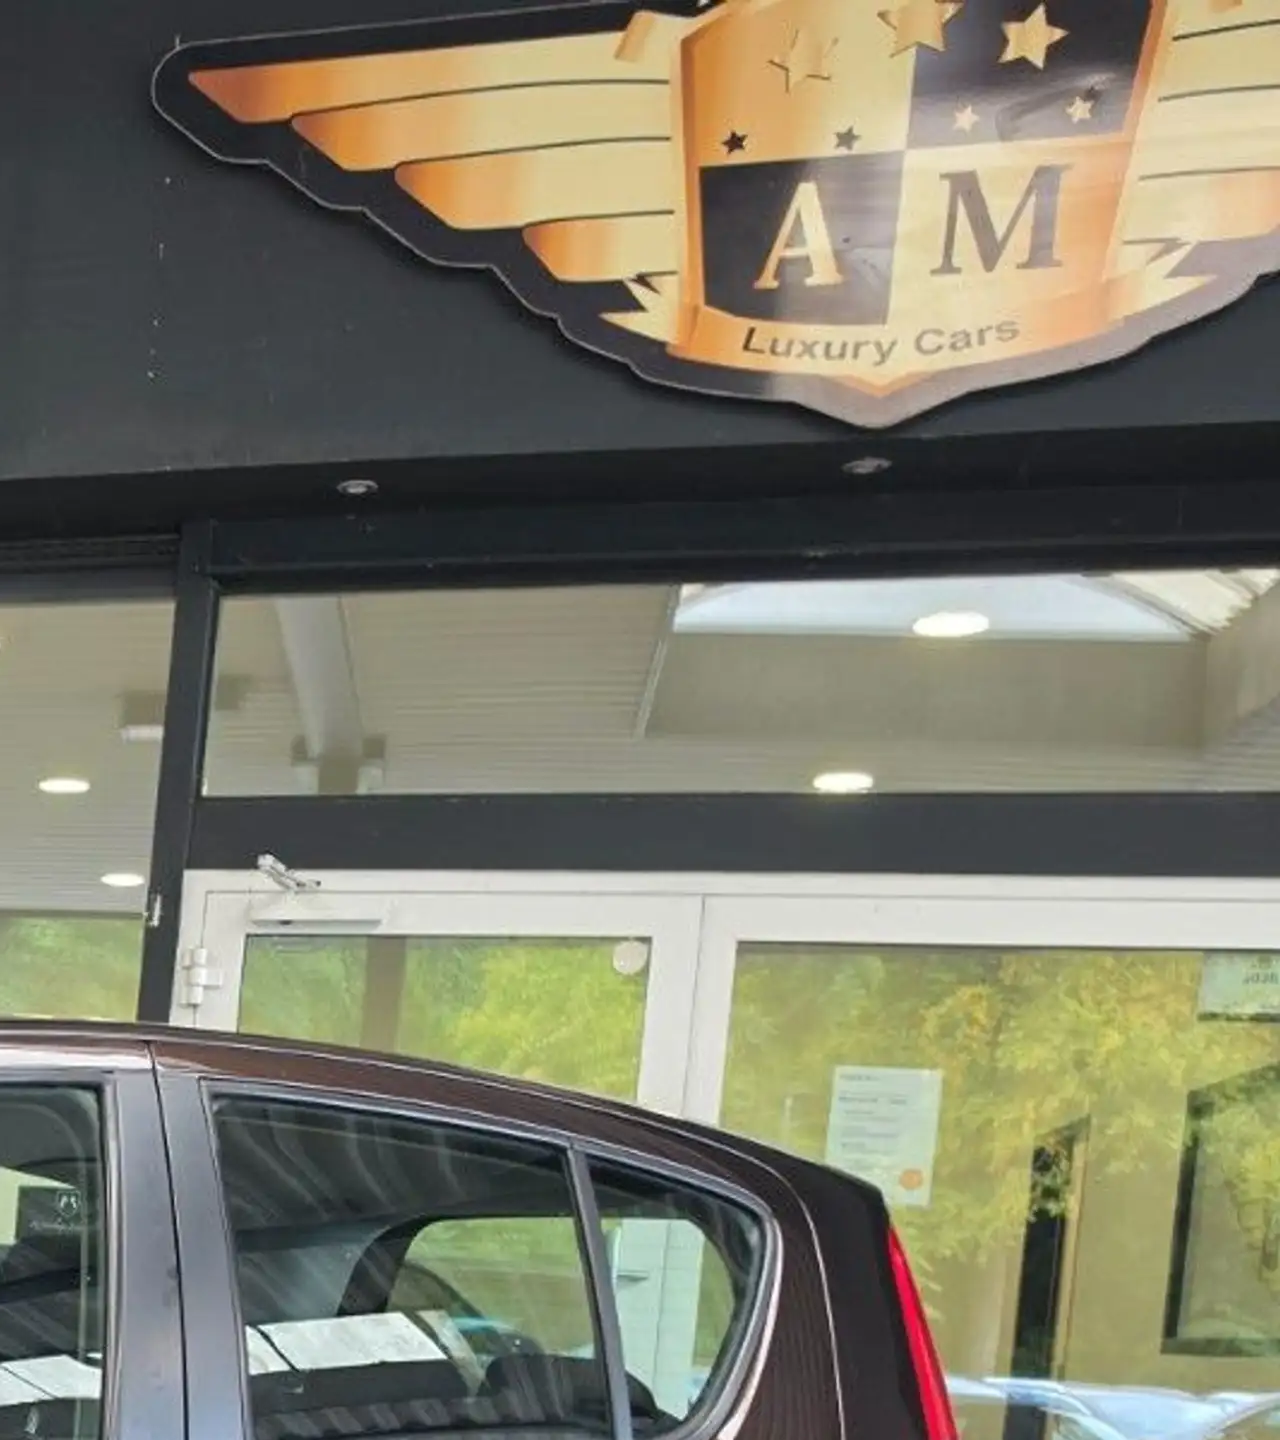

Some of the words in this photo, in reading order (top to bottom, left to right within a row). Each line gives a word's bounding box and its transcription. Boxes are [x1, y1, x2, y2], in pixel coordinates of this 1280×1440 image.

[752, 180, 844, 289] A
[930, 163, 1072, 276] M
[742, 326, 899, 366] Luxury
[913, 318, 1021, 355] Cars
